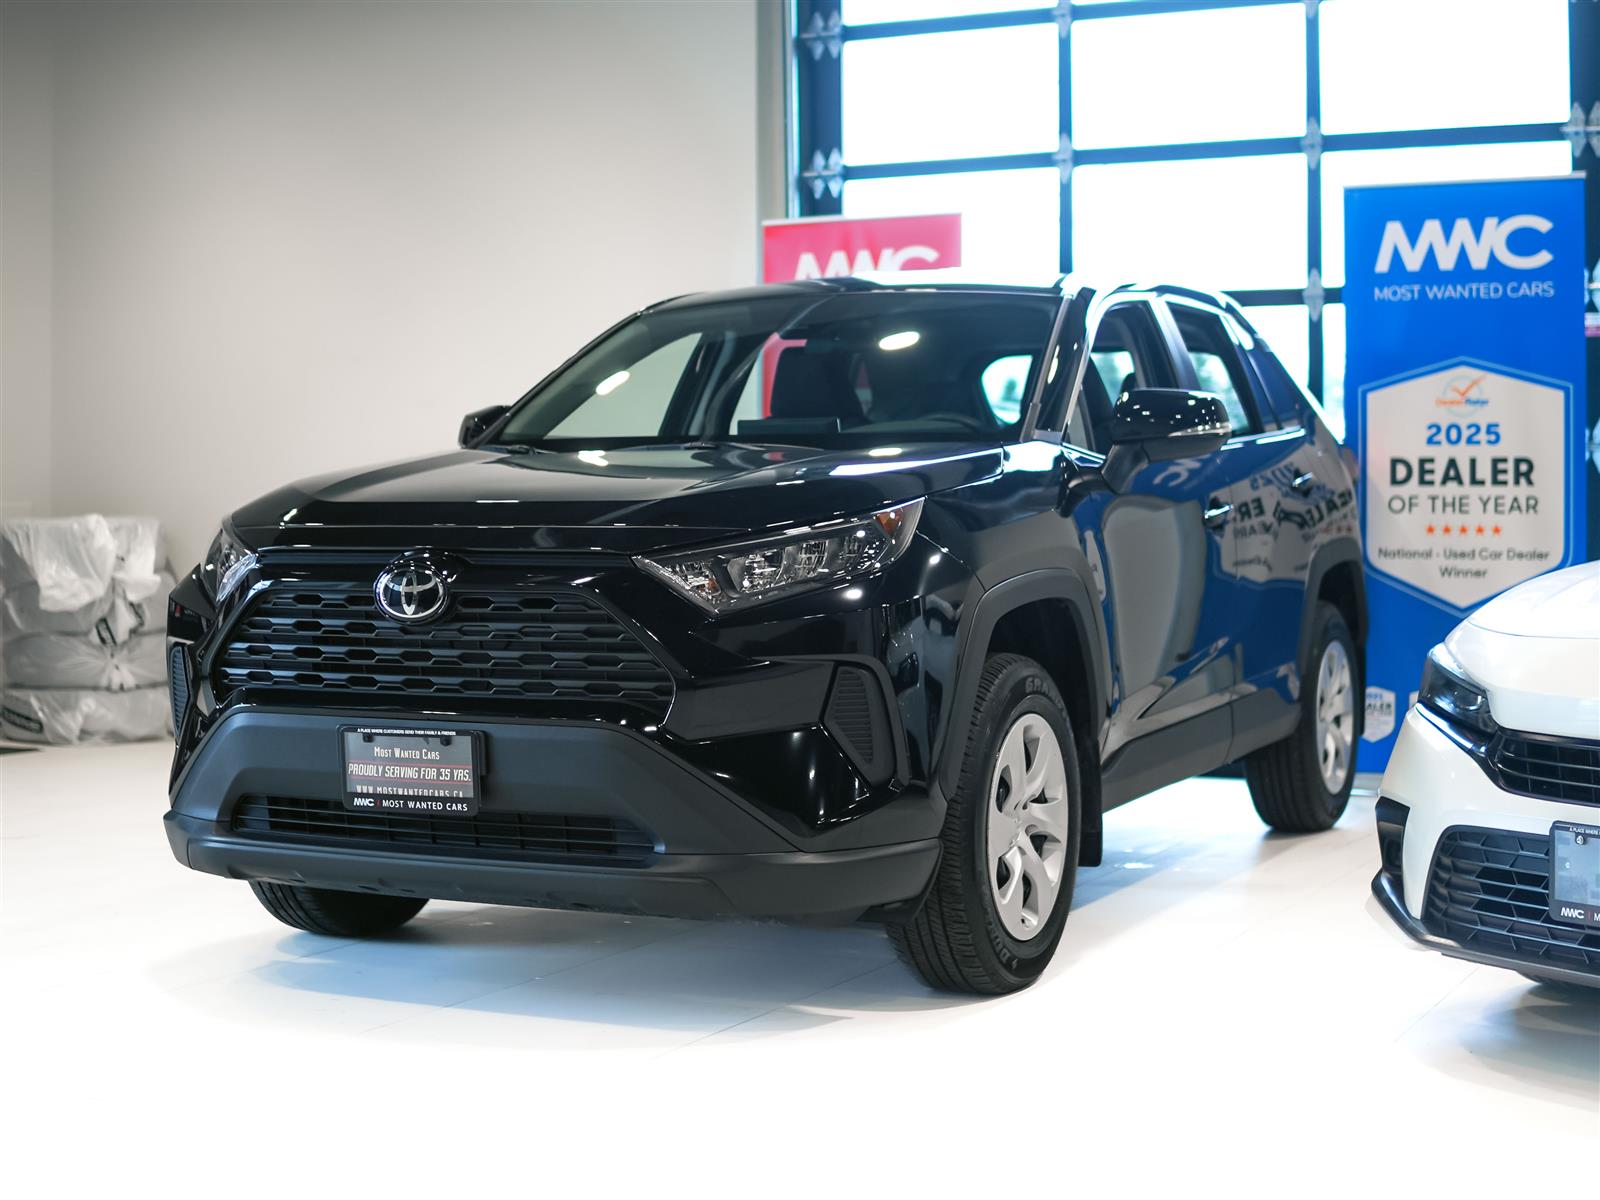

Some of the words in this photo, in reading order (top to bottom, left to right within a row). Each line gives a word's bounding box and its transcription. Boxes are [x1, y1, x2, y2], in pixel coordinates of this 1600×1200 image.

[1374, 214, 1554, 273] MWC
[1374, 284, 1421, 301] MOST
[1425, 282, 1503, 300] WANTED
[1507, 280, 1555, 298] CARS
[1426, 423, 1501, 446] 2025
[1390, 457, 1534, 486] DEALER
[1388, 495, 1419, 514] OF
[1428, 495, 1470, 514] THE
[1478, 495, 1539, 514] YEAR
[1378, 547, 1433, 561] National
[1443, 548, 1476, 561] Used
[1478, 548, 1503, 561] Car
[1506, 547, 1549, 561] Dealer
[1439, 566, 1488, 579] Winner
[348, 763, 383, 777] PROUDLY
[384, 766, 419, 779] SERVING
[420, 767, 437, 780] FOR
[439, 768, 451, 781] 35
[453, 769, 472, 782] YRS.
[353, 797, 375, 807] MWC
[382, 799, 404, 808] MOST
[407, 801, 443, 810] WANTED
[446, 802, 468, 811] CARS
[1560, 907, 1585, 918] MWC
